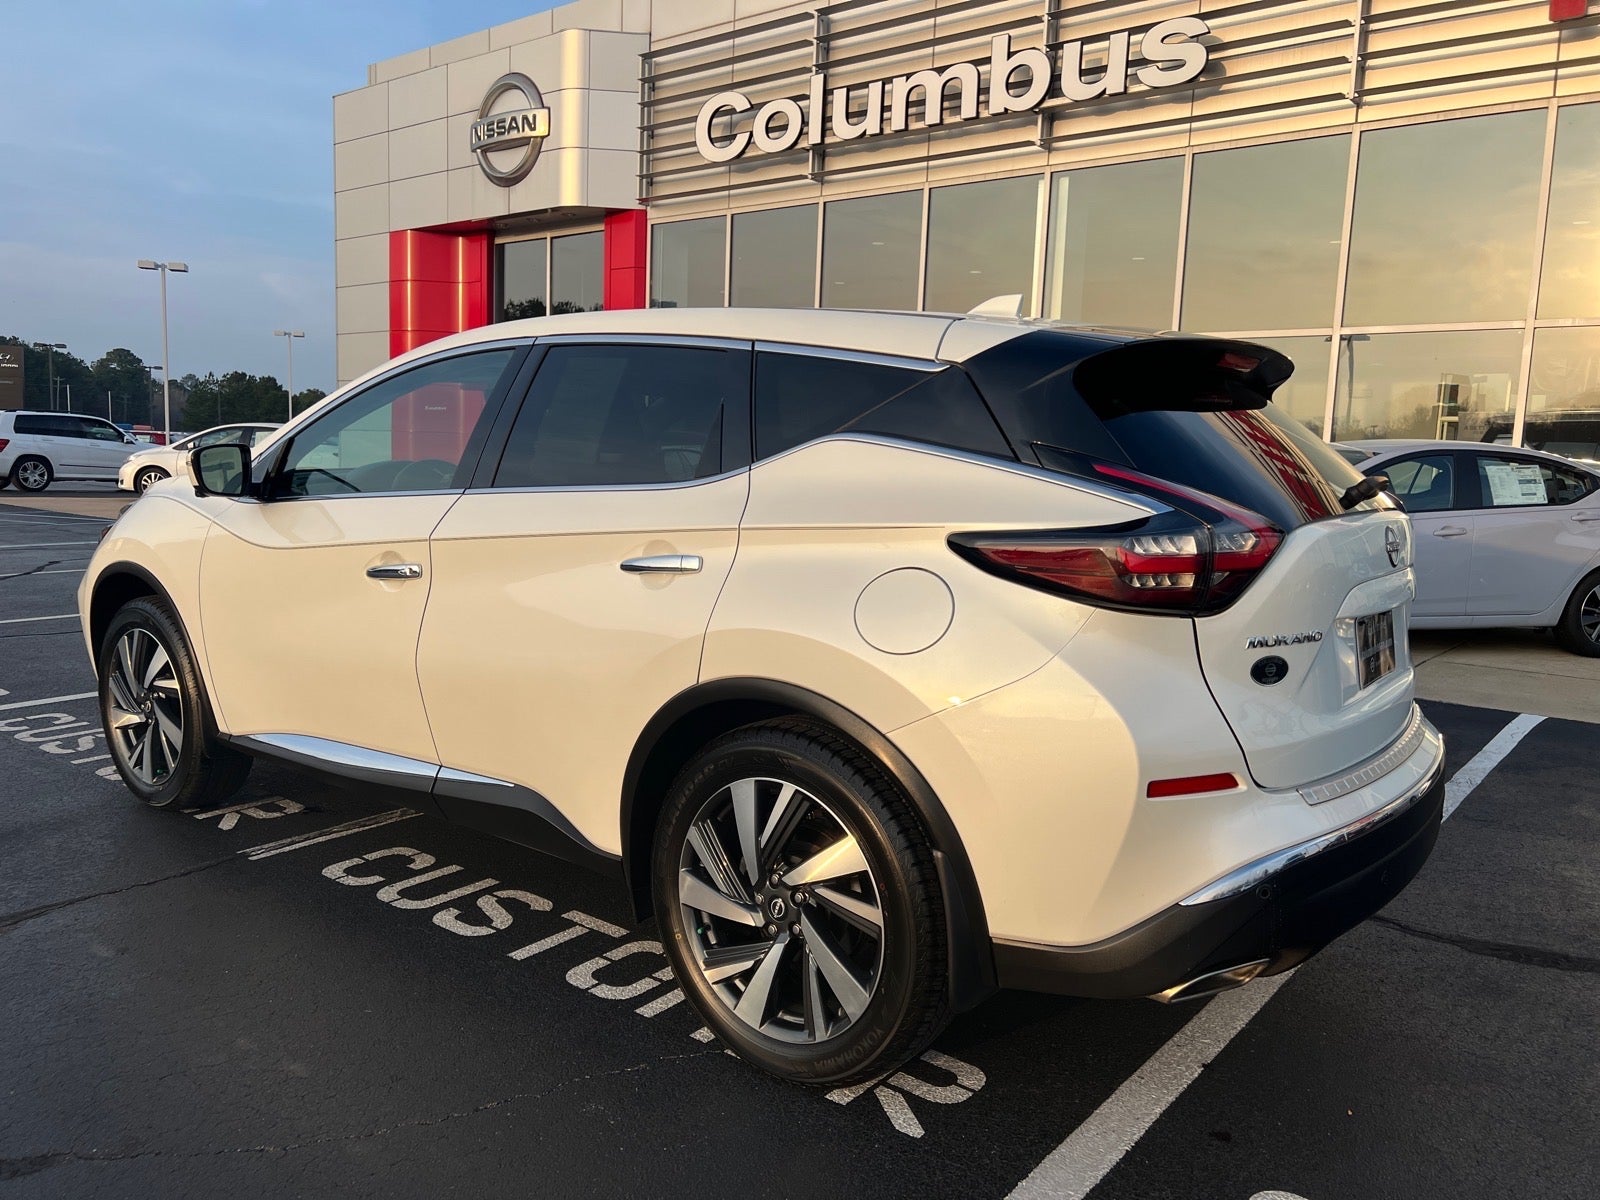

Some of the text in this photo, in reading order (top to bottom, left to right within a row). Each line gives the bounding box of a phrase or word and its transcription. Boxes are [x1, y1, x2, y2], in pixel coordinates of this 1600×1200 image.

[695, 16, 1211, 163] Columbus
[472, 113, 537, 145] NISSAN
[1245, 631, 1323, 650] MURANO
[322, 846, 987, 1139] CUSTOR
[814, 1025, 885, 1069] YOKOHAMA
